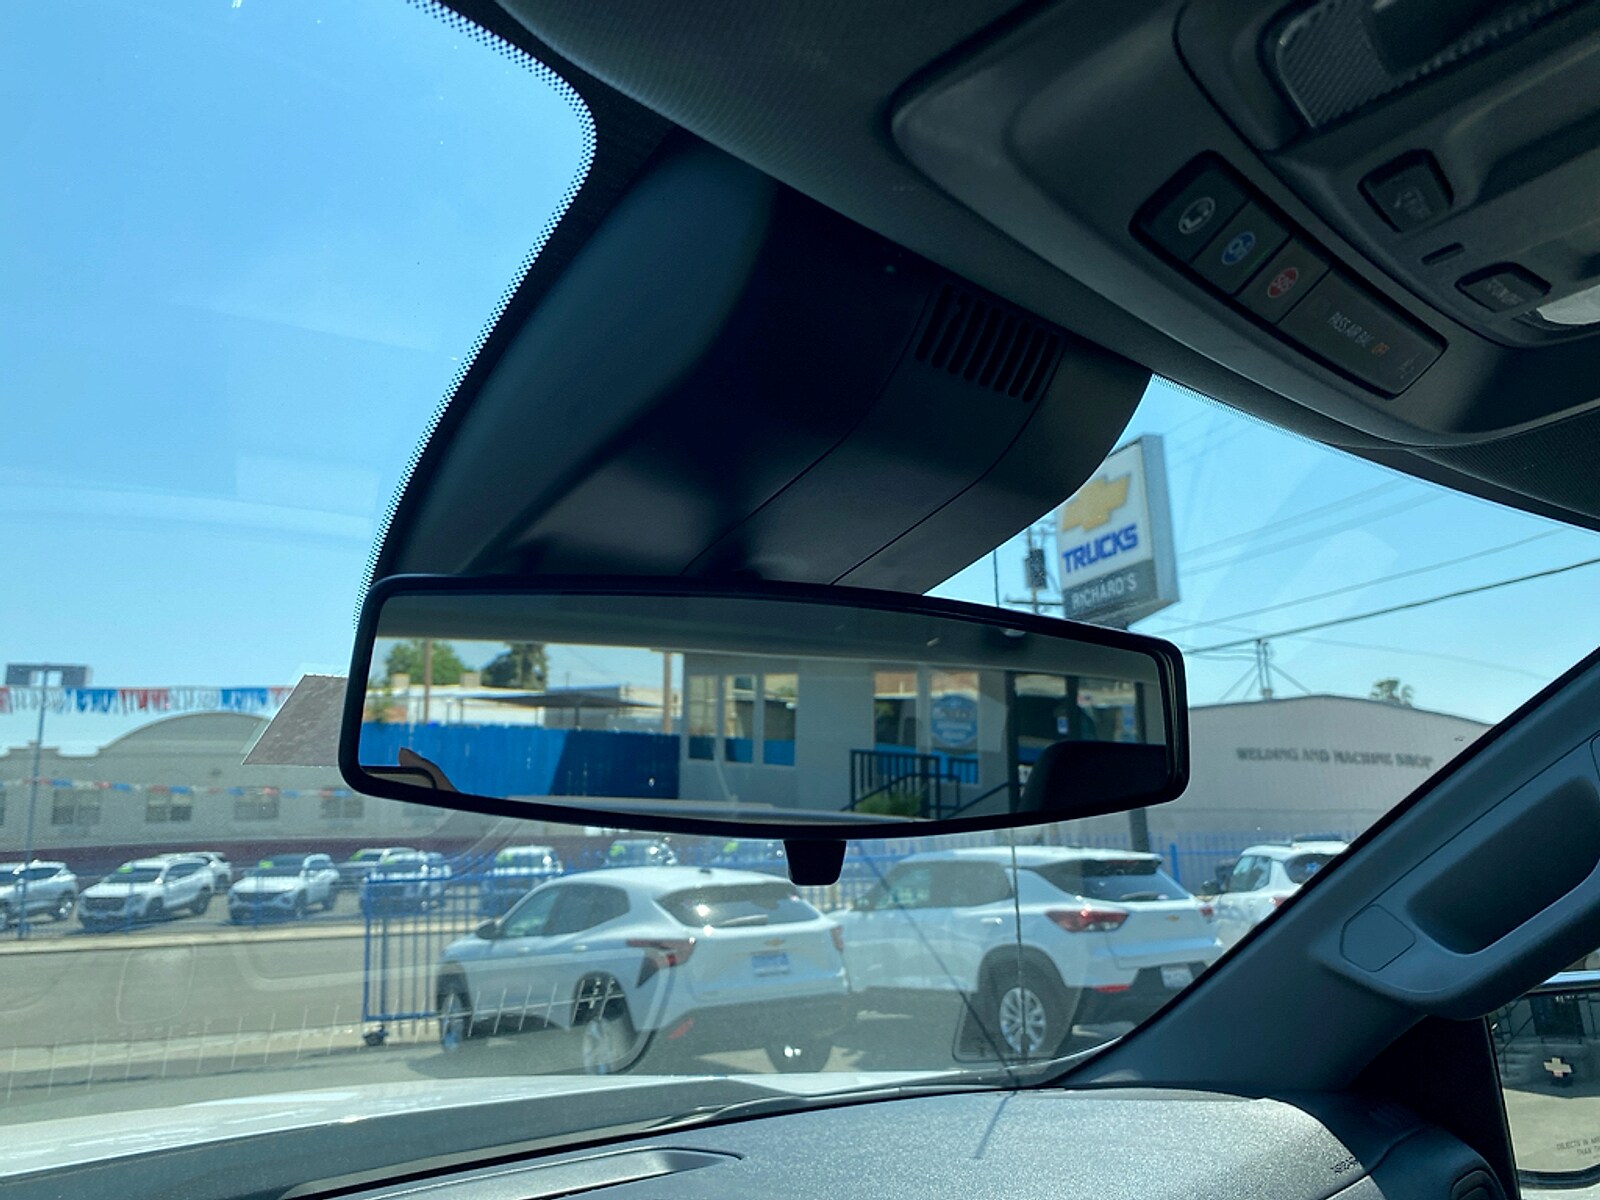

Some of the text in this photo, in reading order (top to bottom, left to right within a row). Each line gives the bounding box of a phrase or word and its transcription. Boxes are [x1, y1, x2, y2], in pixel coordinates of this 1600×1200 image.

[1062, 524, 1138, 573] TRUCKS
[1071, 573, 1137, 609] RICHARD'S
[1236, 747, 1299, 761] WELDING
[1302, 748, 1330, 763] AND
[1333, 750, 1393, 766] MACHINE
